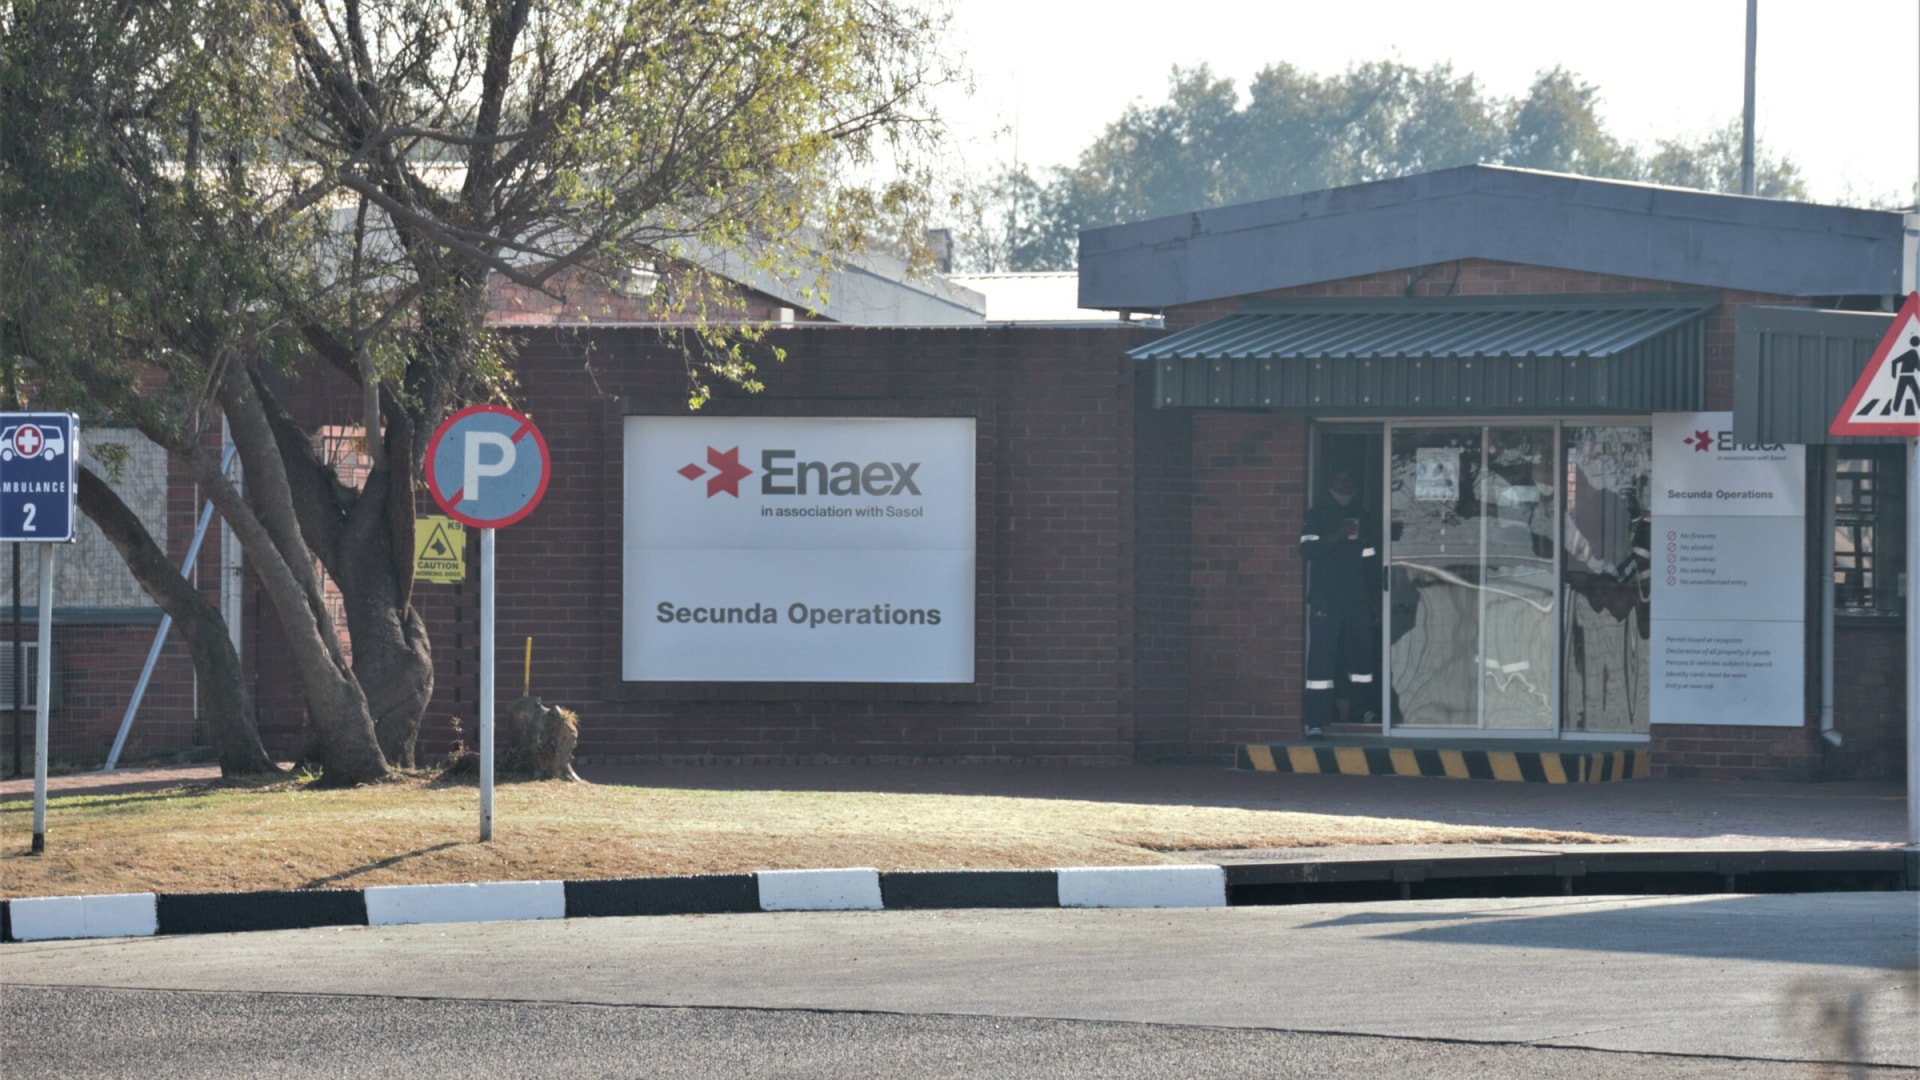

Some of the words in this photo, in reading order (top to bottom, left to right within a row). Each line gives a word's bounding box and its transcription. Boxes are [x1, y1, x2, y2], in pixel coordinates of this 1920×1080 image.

[463, 431, 516, 500] P
[761, 449, 922, 496] Enaex
[0, 482, 65, 493] MBULANCE
[1668, 490, 1712, 499] Secunda
[1716, 490, 1774, 500] Operations
[23, 503, 36, 531] 2
[761, 505, 773, 517] in
[776, 506, 851, 518] association
[856, 506, 883, 518] with
[886, 506, 923, 518] Sasol
[447, 522, 461, 530] K9
[417, 561, 459, 570] CAUTION
[656, 601, 778, 624] Secunda
[787, 602, 942, 628] Operations
